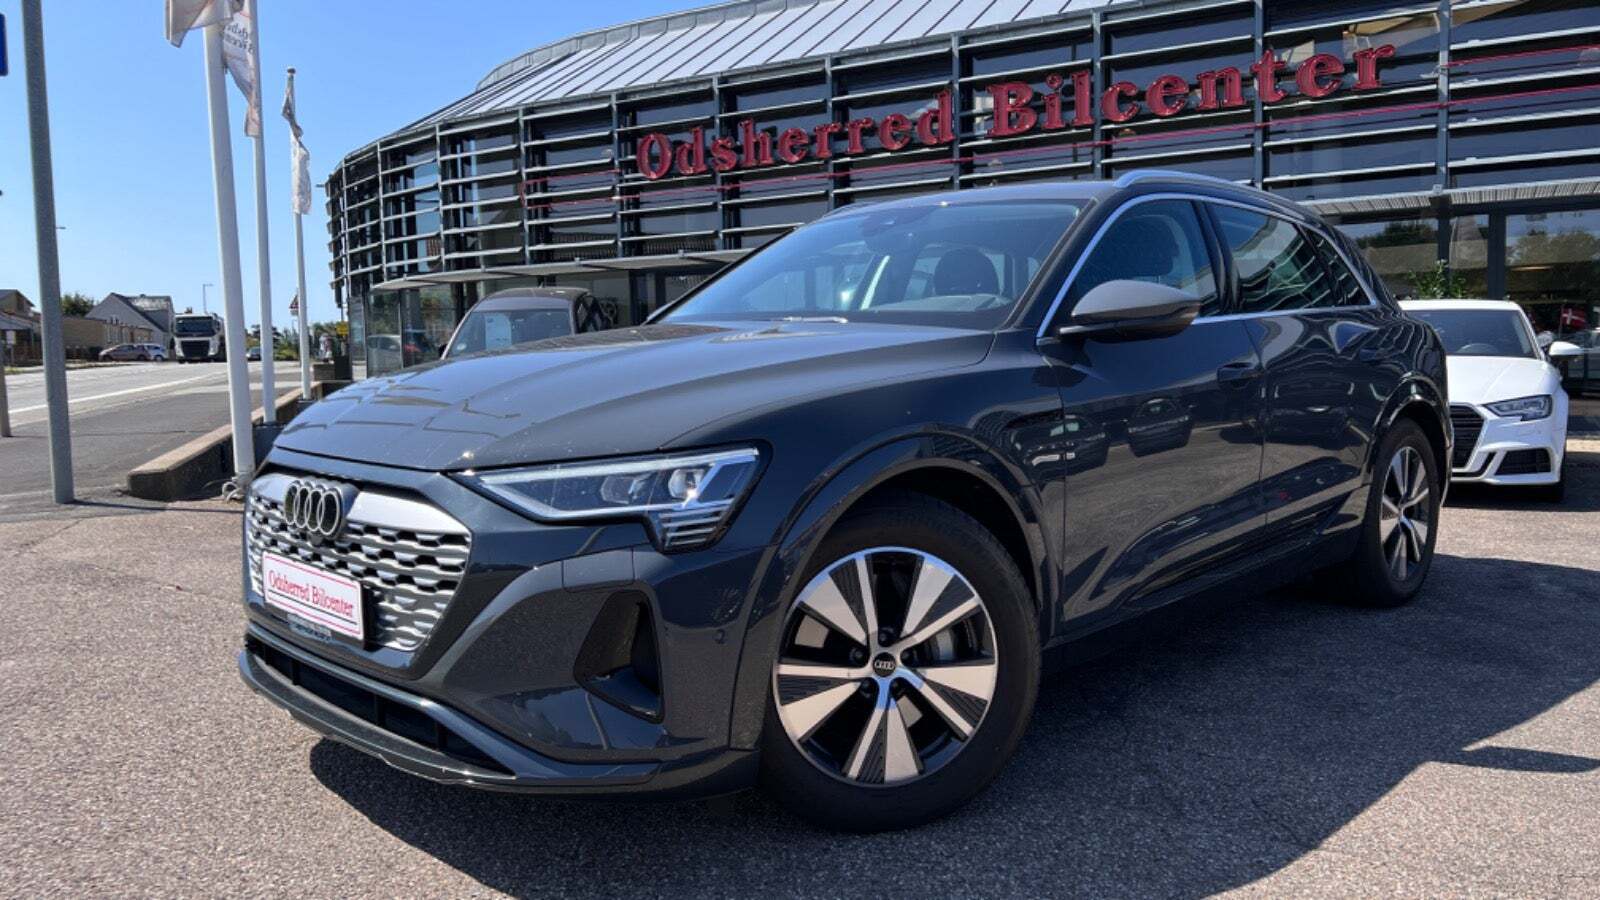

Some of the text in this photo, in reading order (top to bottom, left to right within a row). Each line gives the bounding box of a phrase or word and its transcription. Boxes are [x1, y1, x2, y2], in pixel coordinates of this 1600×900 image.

[636, 43, 1396, 180] Odsherred Bilcenter
[269, 569, 354, 619] Odsherred Bilcenter
